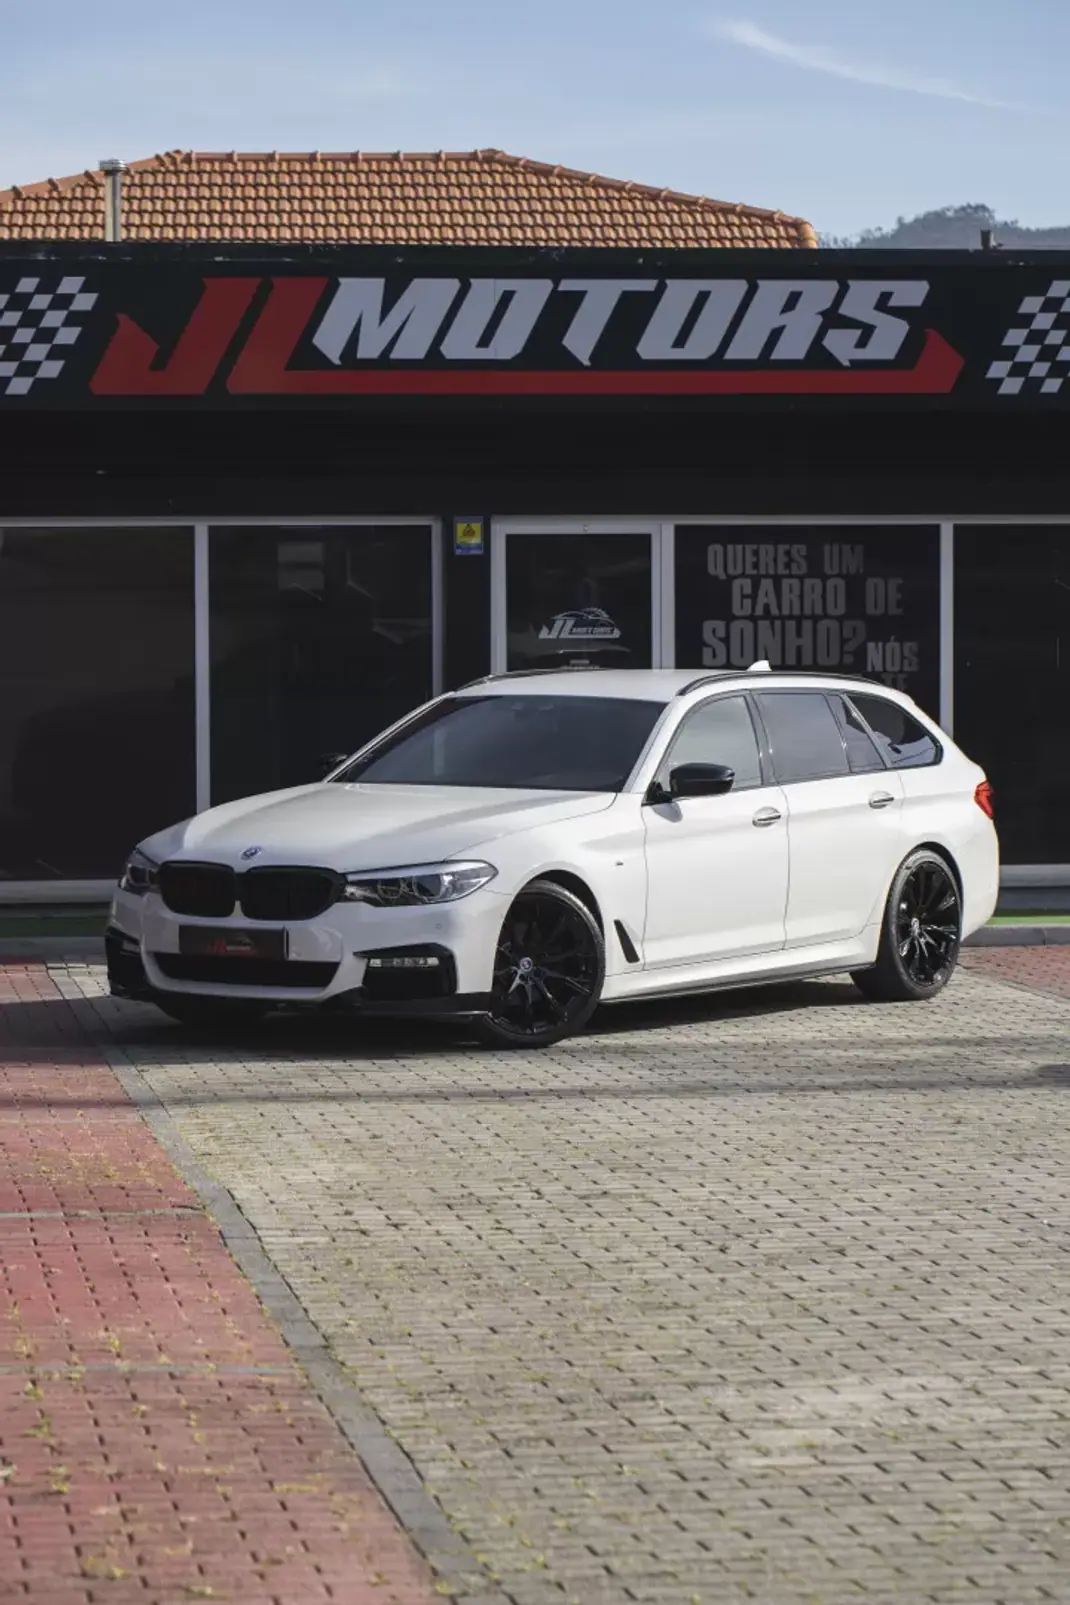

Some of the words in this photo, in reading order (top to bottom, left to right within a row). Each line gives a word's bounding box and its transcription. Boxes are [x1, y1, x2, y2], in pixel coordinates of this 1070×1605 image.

[706, 543, 807, 579] QUERES
[823, 543, 865, 575] UM
[731, 577, 847, 616] CARRO
[864, 577, 904, 615] DE
[702, 618, 867, 667] SONHO?
[866, 635, 920, 672] NÓS
